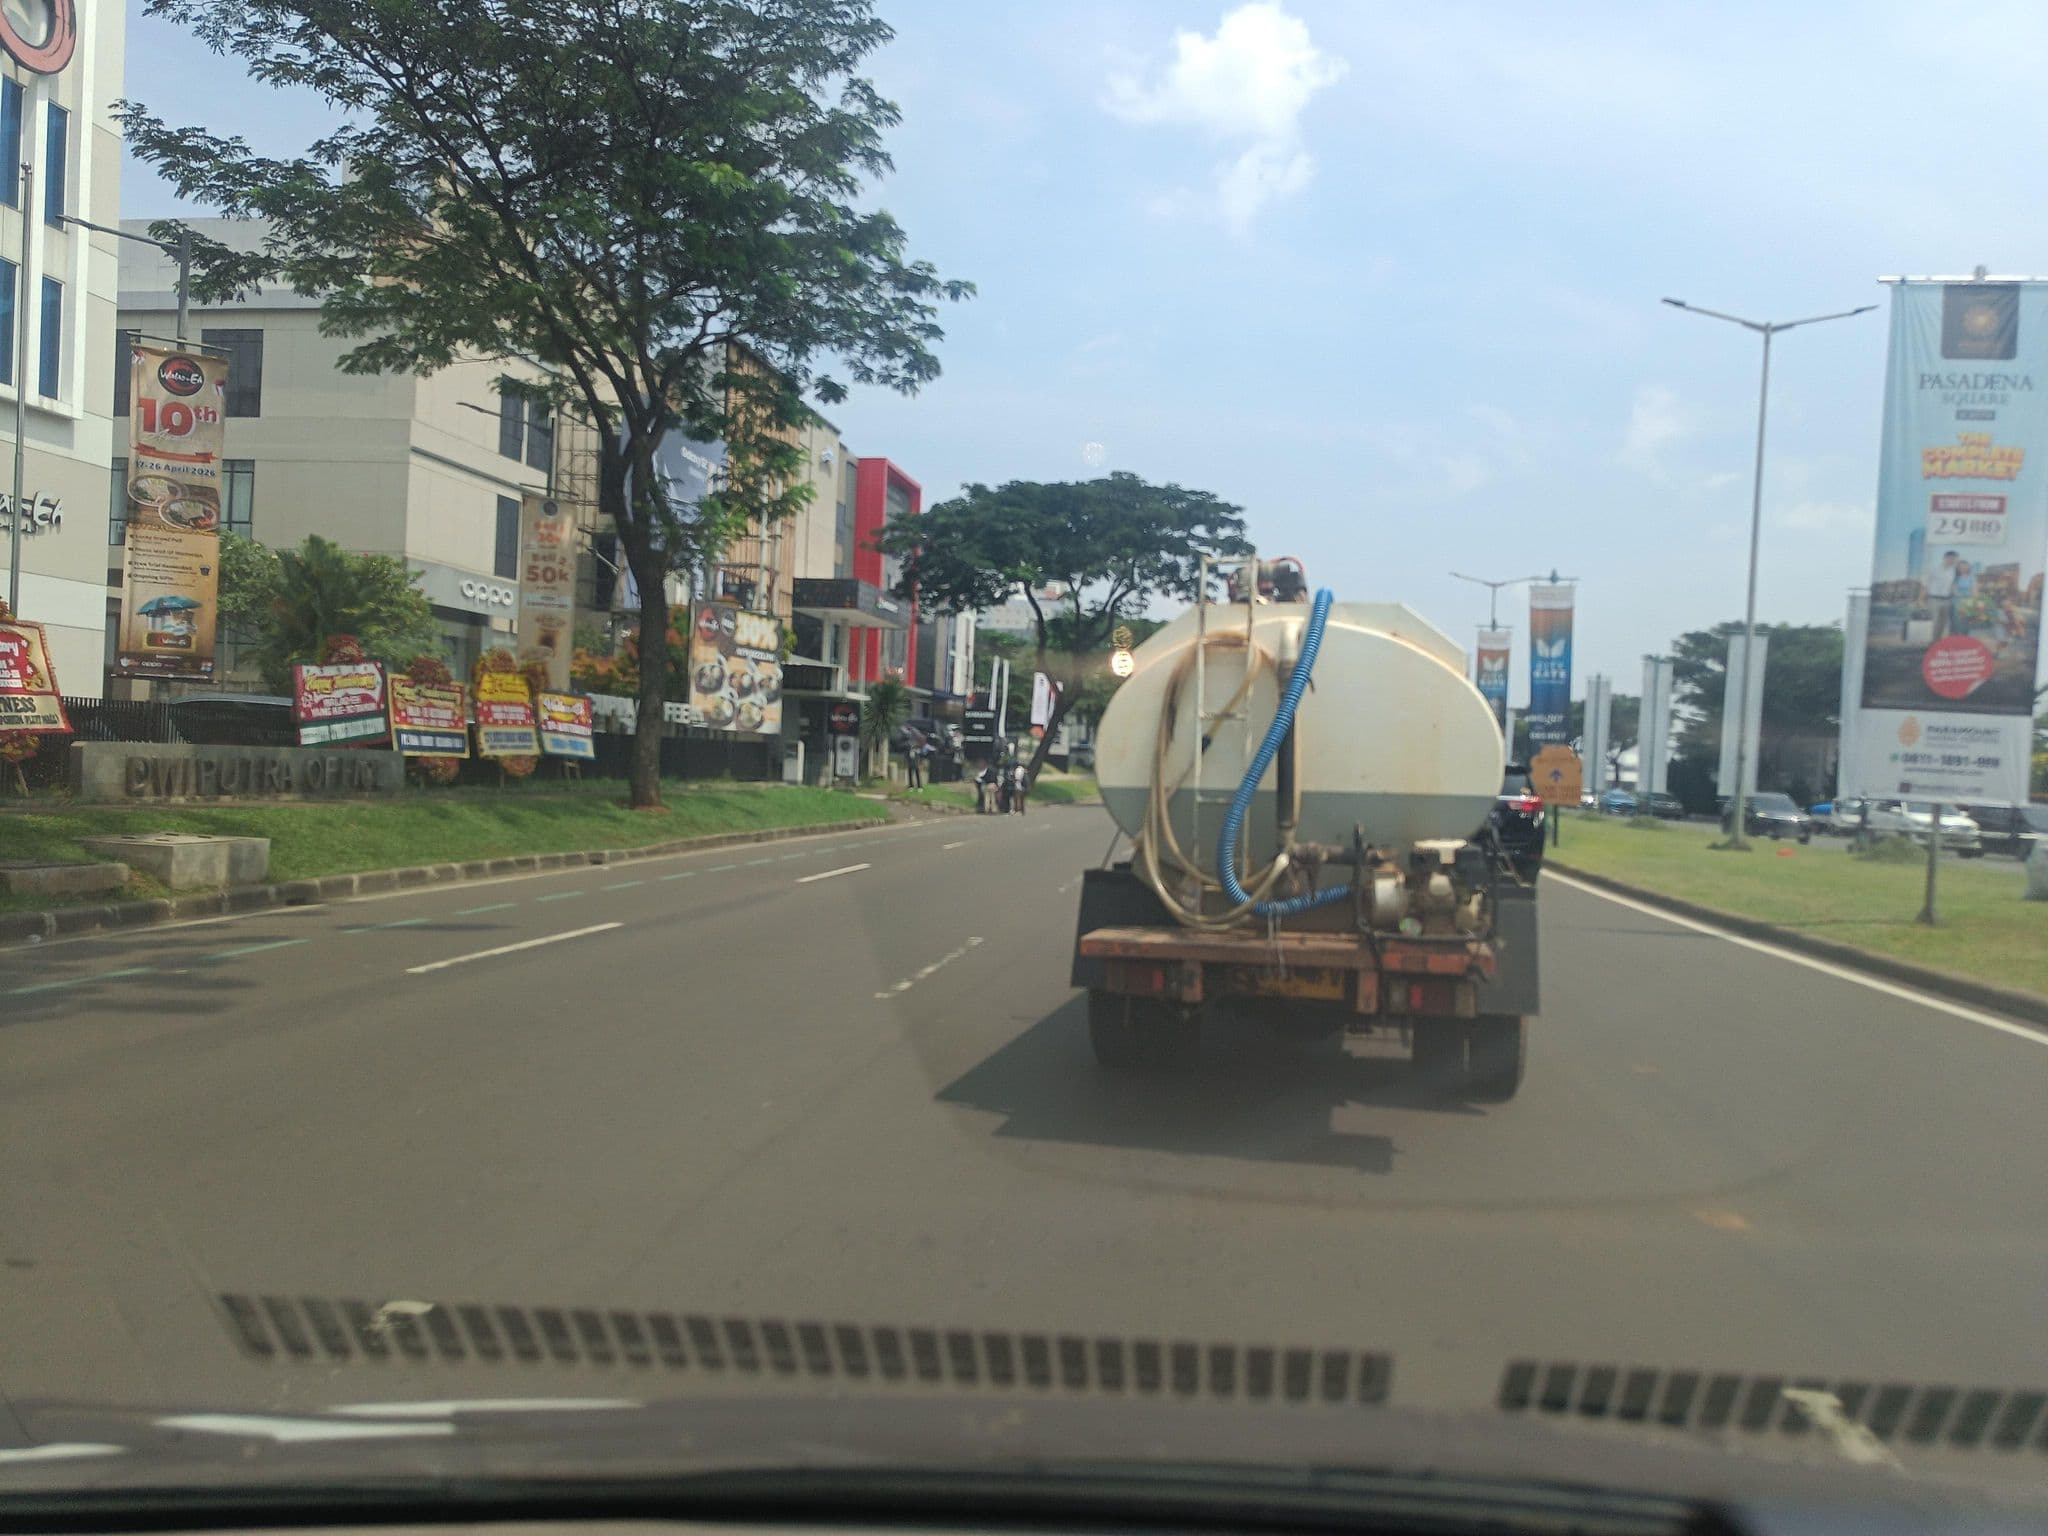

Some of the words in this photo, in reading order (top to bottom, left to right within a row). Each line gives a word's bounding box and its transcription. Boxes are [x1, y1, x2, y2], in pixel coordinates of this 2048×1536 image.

[1919, 374, 2034, 391] PASADENA
[137, 397, 218, 437] 10th
[163, 463, 189, 476] April
[190, 467, 216, 477] 2026
[461, 580, 514, 607] oppo
